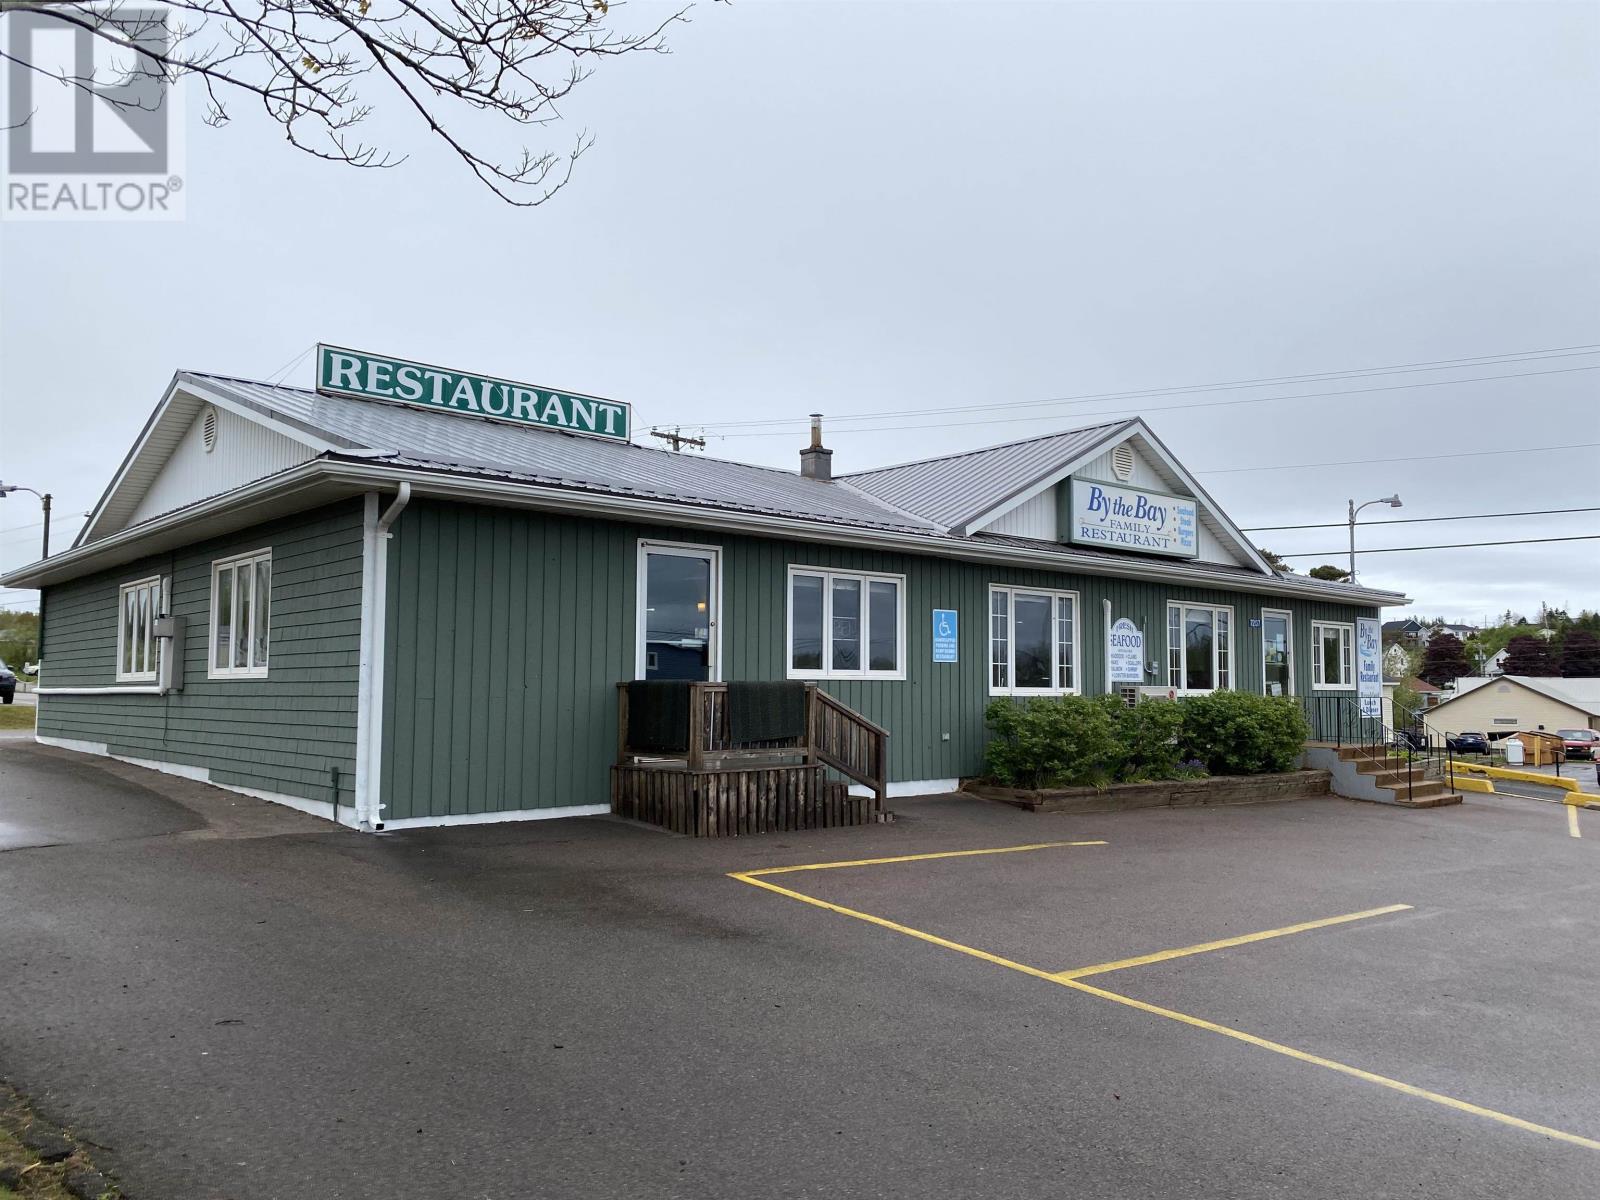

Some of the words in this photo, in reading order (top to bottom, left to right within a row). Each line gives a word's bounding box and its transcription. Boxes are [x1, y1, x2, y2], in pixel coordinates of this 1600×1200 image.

[328, 352, 622, 434] RESTAURANT
[1087, 486, 1110, 522] By
[1113, 496, 1133, 517] the
[1133, 494, 1167, 531] Bay
[1080, 526, 1170, 549] RESTAURANT
[1110, 519, 1151, 534] FAMILY
[1116, 622, 1134, 633] FRESH
